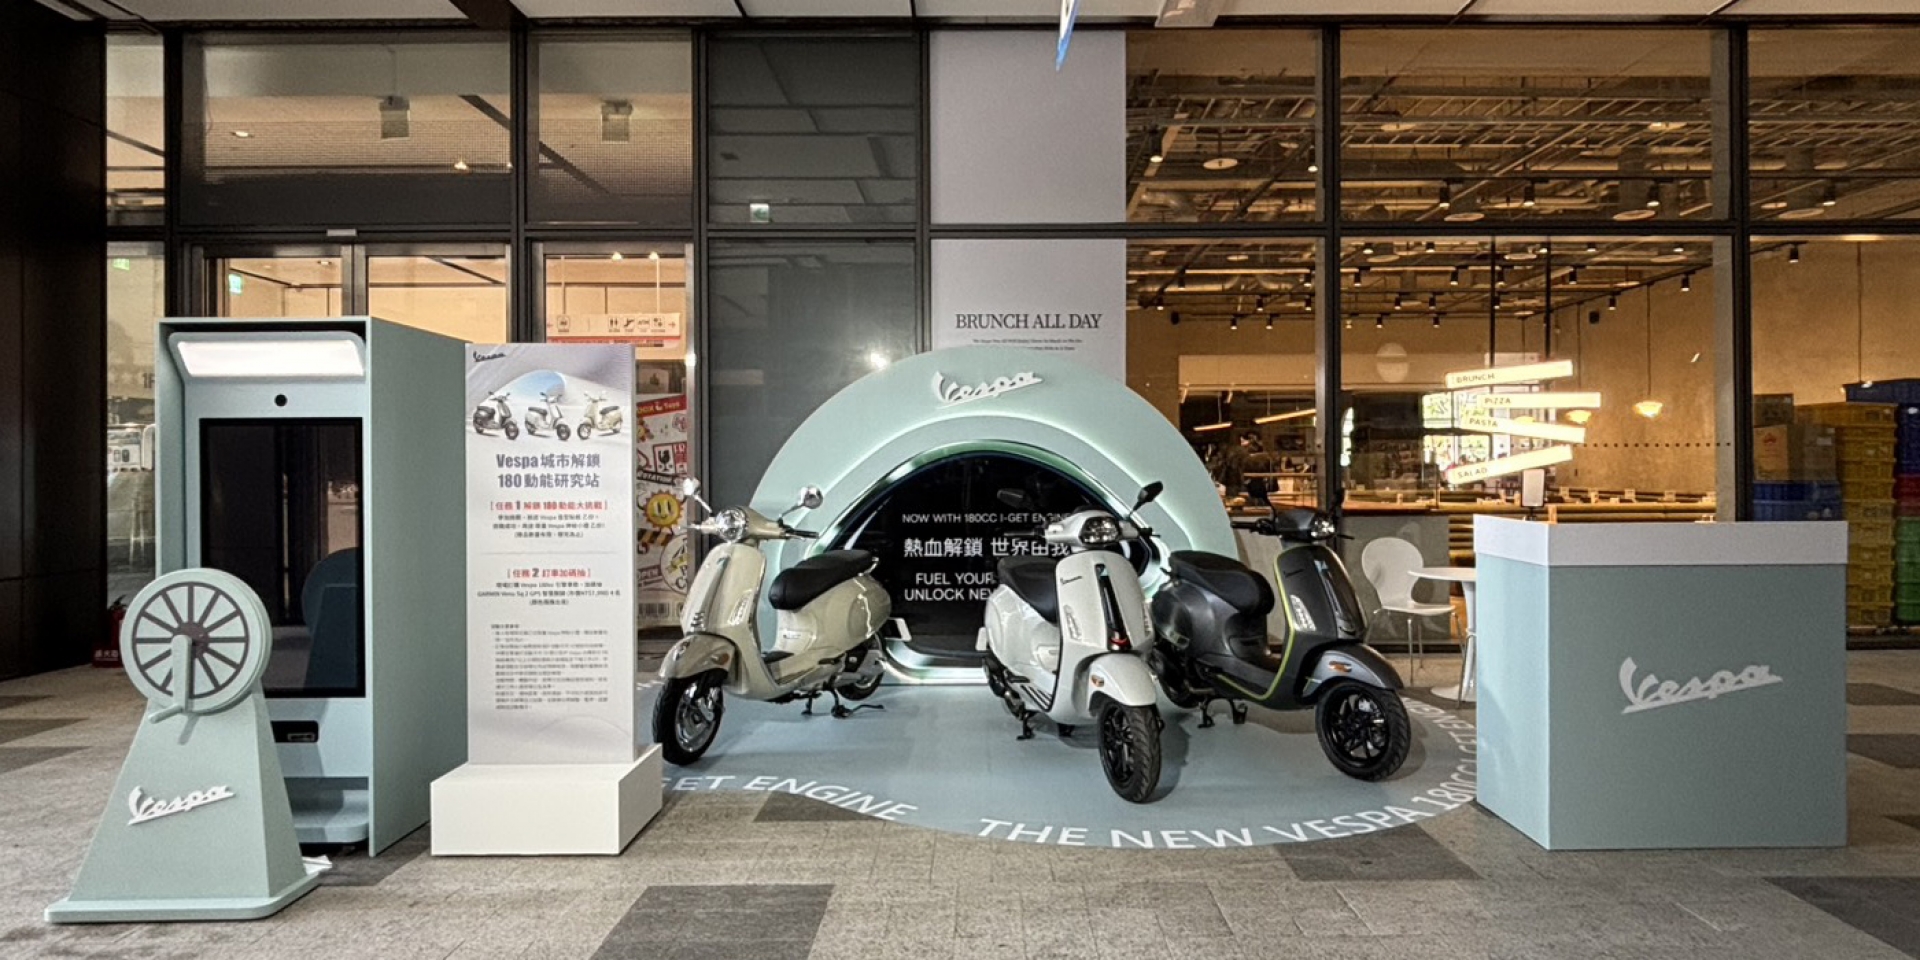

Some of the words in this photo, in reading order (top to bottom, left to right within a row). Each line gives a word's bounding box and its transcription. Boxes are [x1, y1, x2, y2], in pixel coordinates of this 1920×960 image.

[955, 313, 1029, 329] BRUNCH
[1032, 313, 1066, 329] ALL
[1069, 313, 1103, 329] DAY
[1456, 373, 1495, 384] BRUNCH
[931, 370, 1043, 409] Vespa
[1484, 397, 1511, 405] PIZZA
[1469, 418, 1498, 428] PASTA
[496, 453, 539, 469] Vespa
[540, 453, 601, 469] 城市解鎖
[498, 473, 522, 488] 180
[524, 473, 600, 488] 動能研究站
[1457, 467, 1488, 479] SALAD
[902, 513, 931, 523] NOW
[932, 513, 961, 523] WITH
[964, 513, 998, 523] 180CC
[1000, 513, 1029, 523] I-GET
[903, 537, 983, 557] 熱血解鎖
[990, 537, 1070, 557] 世界由我
[916, 573, 950, 585] FUEL
[955, 573, 997, 585] YOUR
[904, 588, 964, 600] UNLOCK
[1618, 656, 1784, 715] Vespa
[743, 775, 919, 821] ENGINE
[127, 785, 236, 827] Vespa
[976, 818, 1089, 847] THE
[1110, 827, 1253, 849] NEW
[1264, 804, 1426, 843] VESPA
